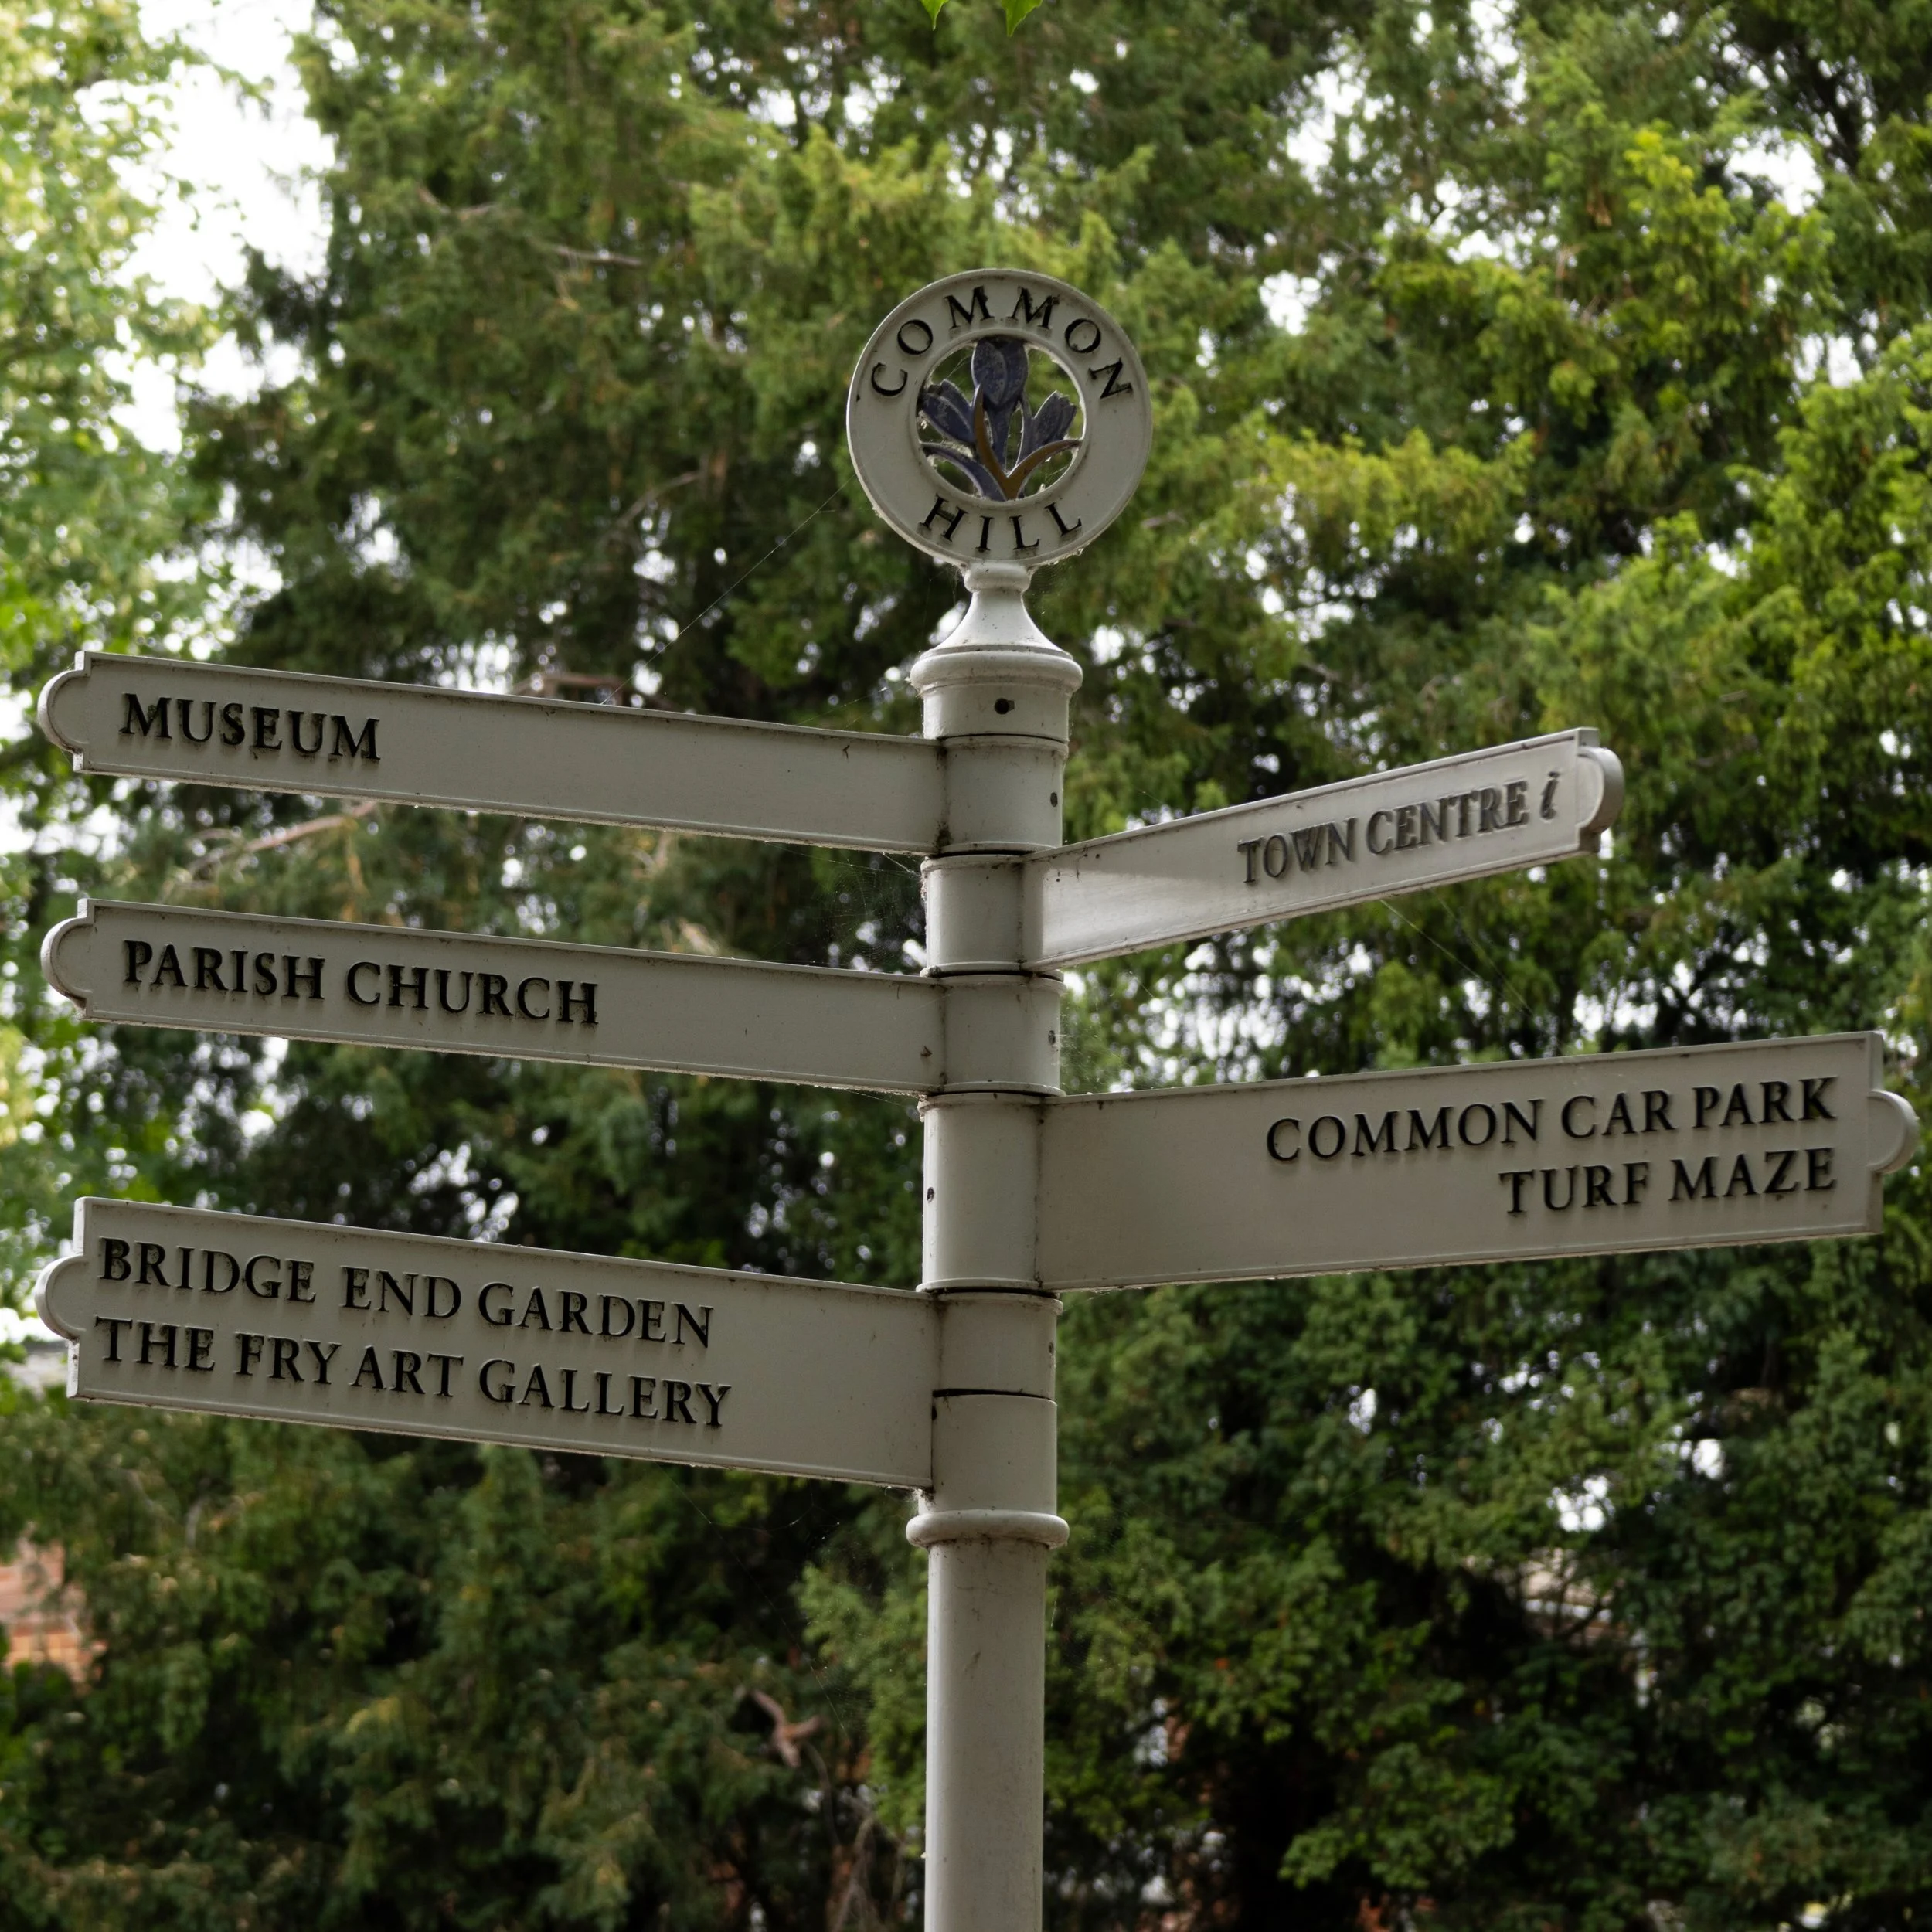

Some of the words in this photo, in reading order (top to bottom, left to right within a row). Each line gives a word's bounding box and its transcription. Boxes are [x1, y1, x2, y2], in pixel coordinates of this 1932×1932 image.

[871, 286, 1134, 399] COMMON
[920, 494, 1082, 552] HILL
[119, 693, 380, 760] MUSEUM
[1238, 817, 1358, 883] TOWN
[1366, 779, 1529, 855] CENTRE
[123, 939, 326, 1000] PARISH
[347, 961, 598, 1025] CHURCH
[1267, 1098, 1543, 1161] COMMON
[1560, 1089, 1676, 1138] CAR
[1692, 1077, 1838, 1128] PARK
[1498, 1161, 1651, 1215] TURF
[1670, 1147, 1837, 1202] MAZE
[99, 1236, 317, 1304] BRIDGE
[341, 1264, 462, 1320] END
[478, 1281, 713, 1349] GARDEN
[94, 1315, 216, 1372] THE
[235, 1332, 342, 1385] FRY
[352, 1345, 464, 1398] ART
[479, 1359, 731, 1428] GALLERY
